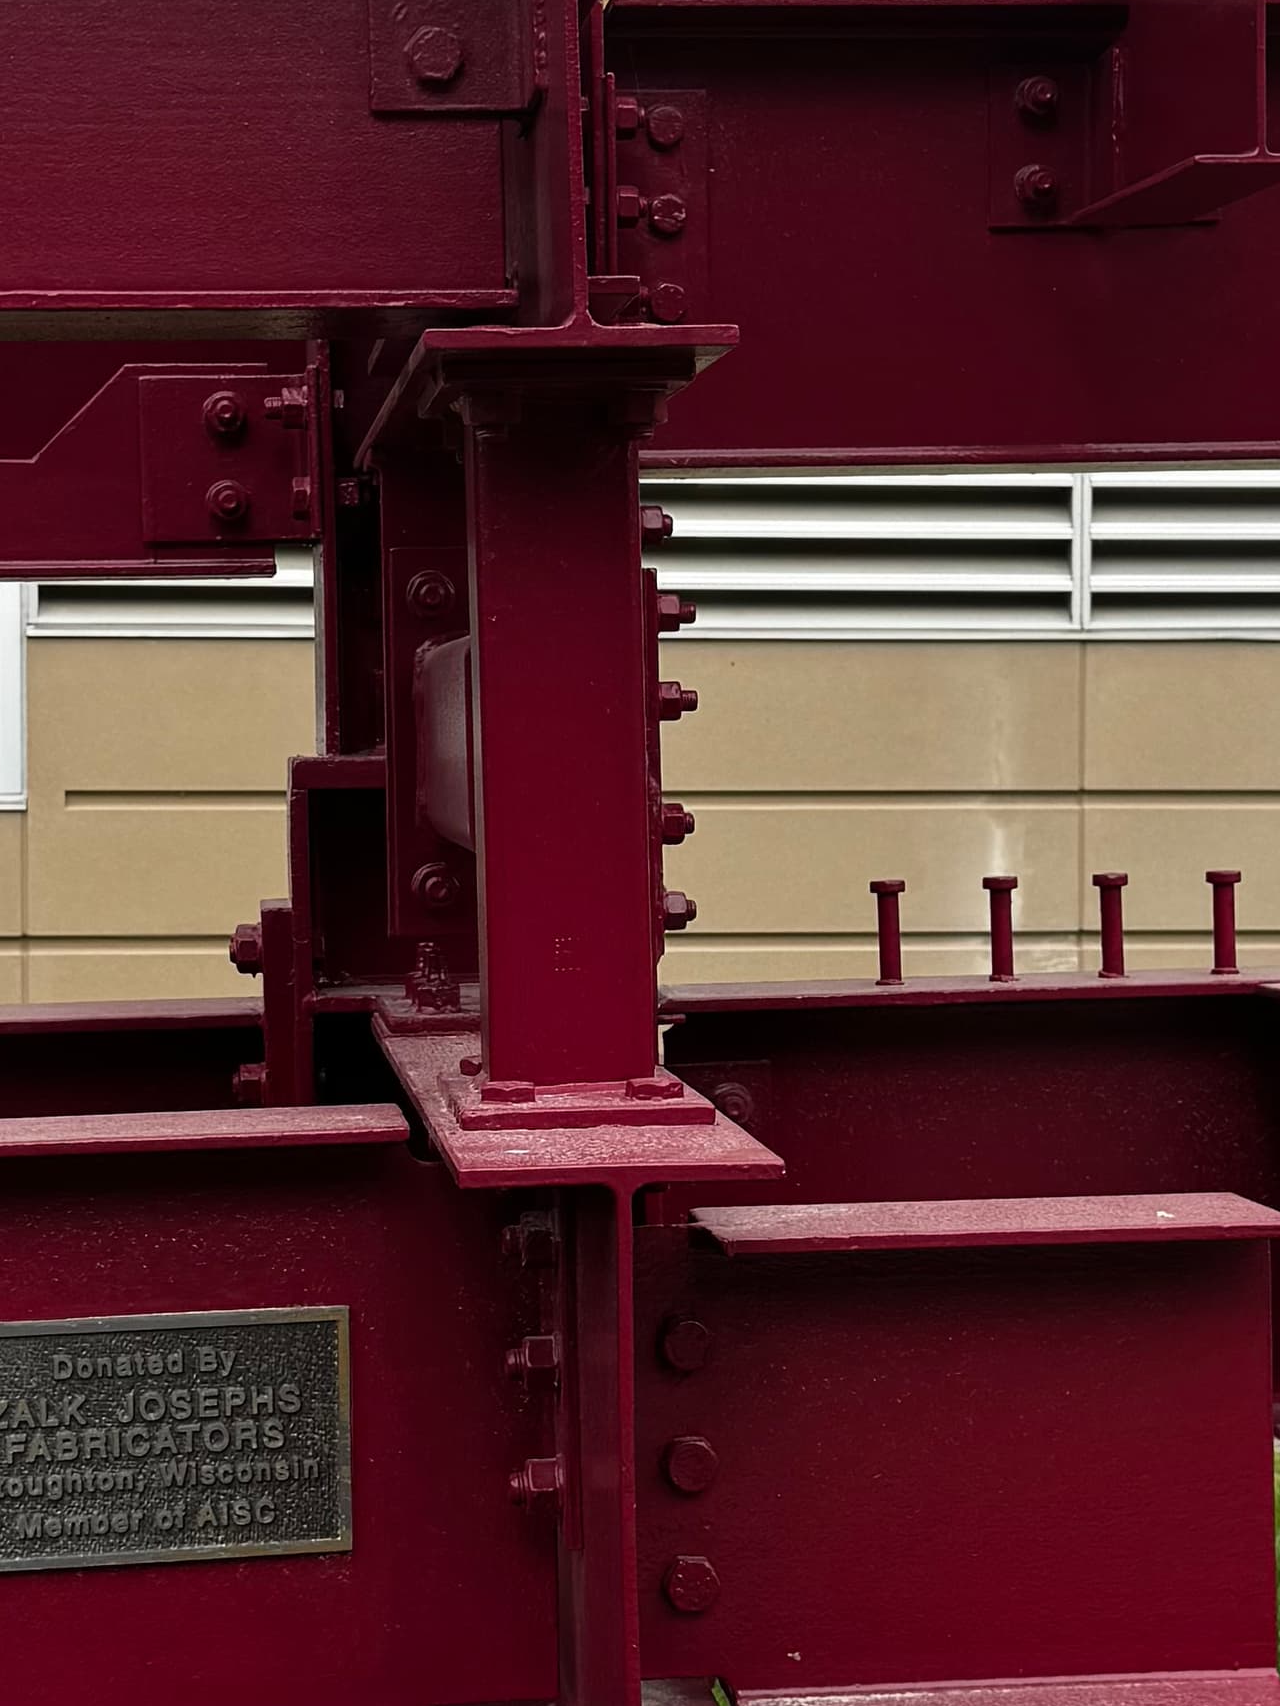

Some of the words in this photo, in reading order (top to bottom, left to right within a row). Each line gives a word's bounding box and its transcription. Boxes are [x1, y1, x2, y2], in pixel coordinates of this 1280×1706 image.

[52, 1350, 184, 1381] Donated
[198, 1346, 237, 1376] By
[118, 1383, 302, 1423] JOSEPHS
[5, 1419, 286, 1464] FABRICATORS
[158, 1456, 320, 1489] Wisconsin
[17, 1510, 144, 1540] Member
[158, 1504, 186, 1532] of
[196, 1498, 277, 1529] AISC
